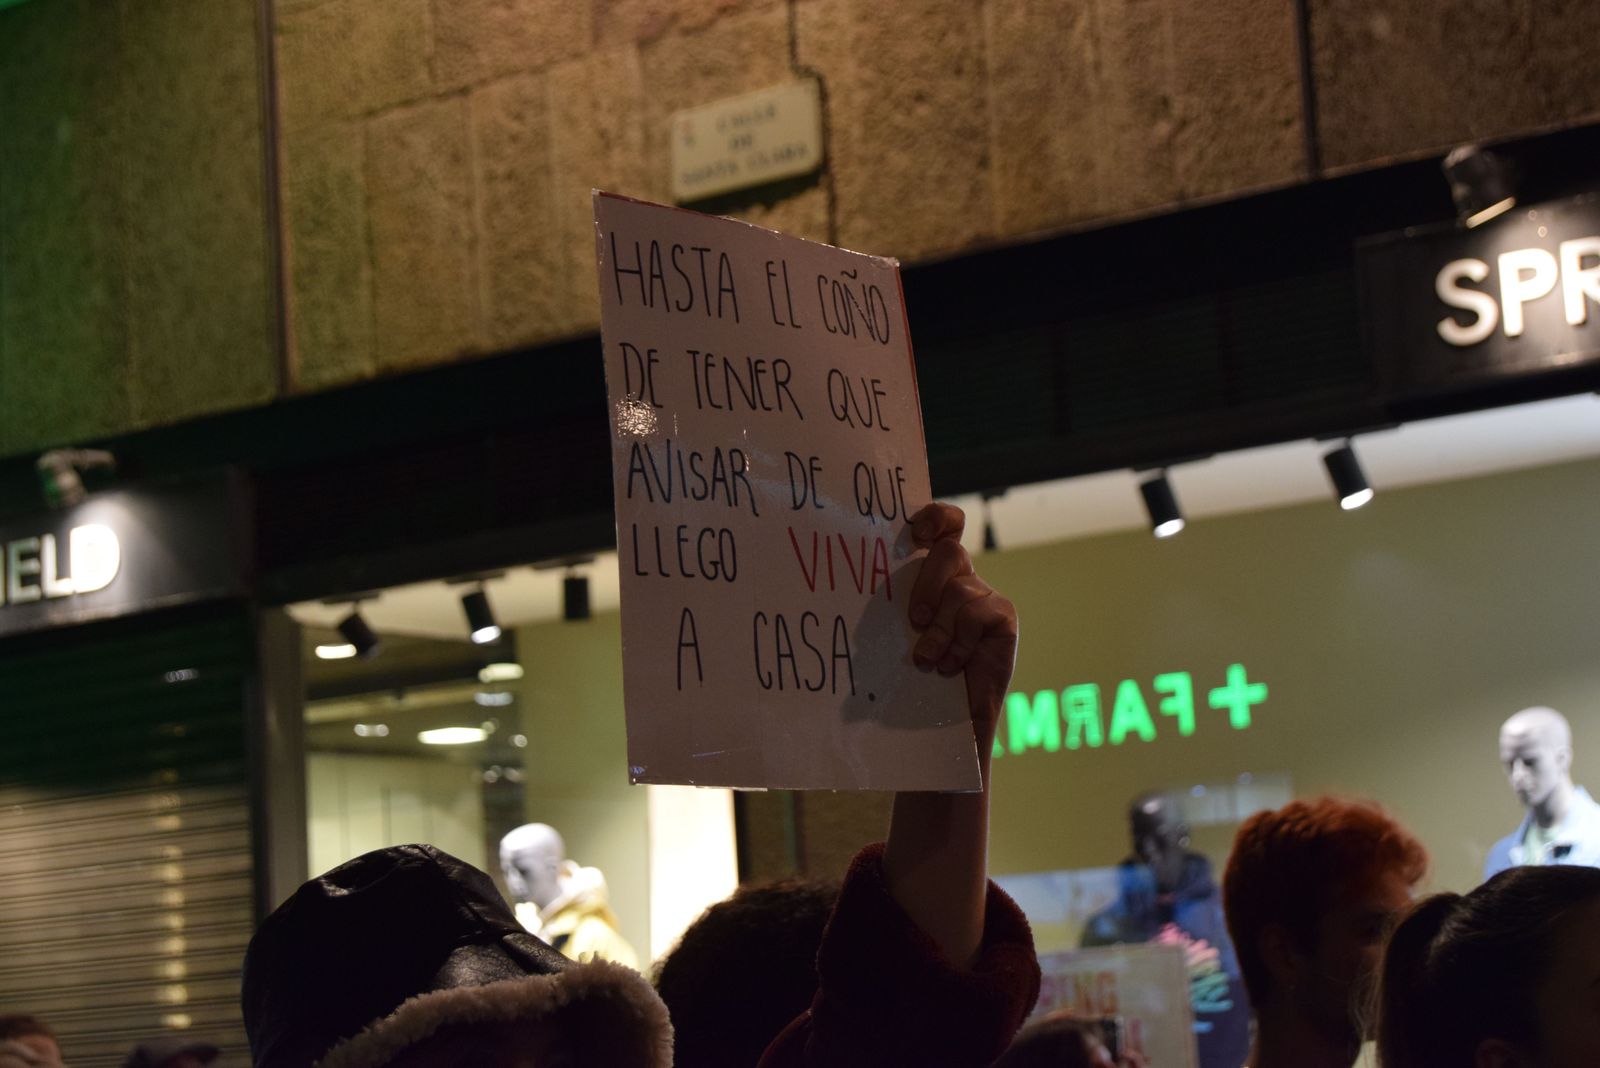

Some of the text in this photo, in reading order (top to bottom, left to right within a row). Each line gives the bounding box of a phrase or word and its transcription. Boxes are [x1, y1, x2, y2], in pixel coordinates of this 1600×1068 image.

[611, 232, 890, 345] HASTA EL COÑO
[1435, 236, 1600, 346] SPR
[619, 342, 890, 431] DE TENER QUE
[627, 439, 914, 525] AVISAR DE QUE
[632, 523, 892, 601] LLEGO VIVA
[677, 607, 876, 701] A CASA.
